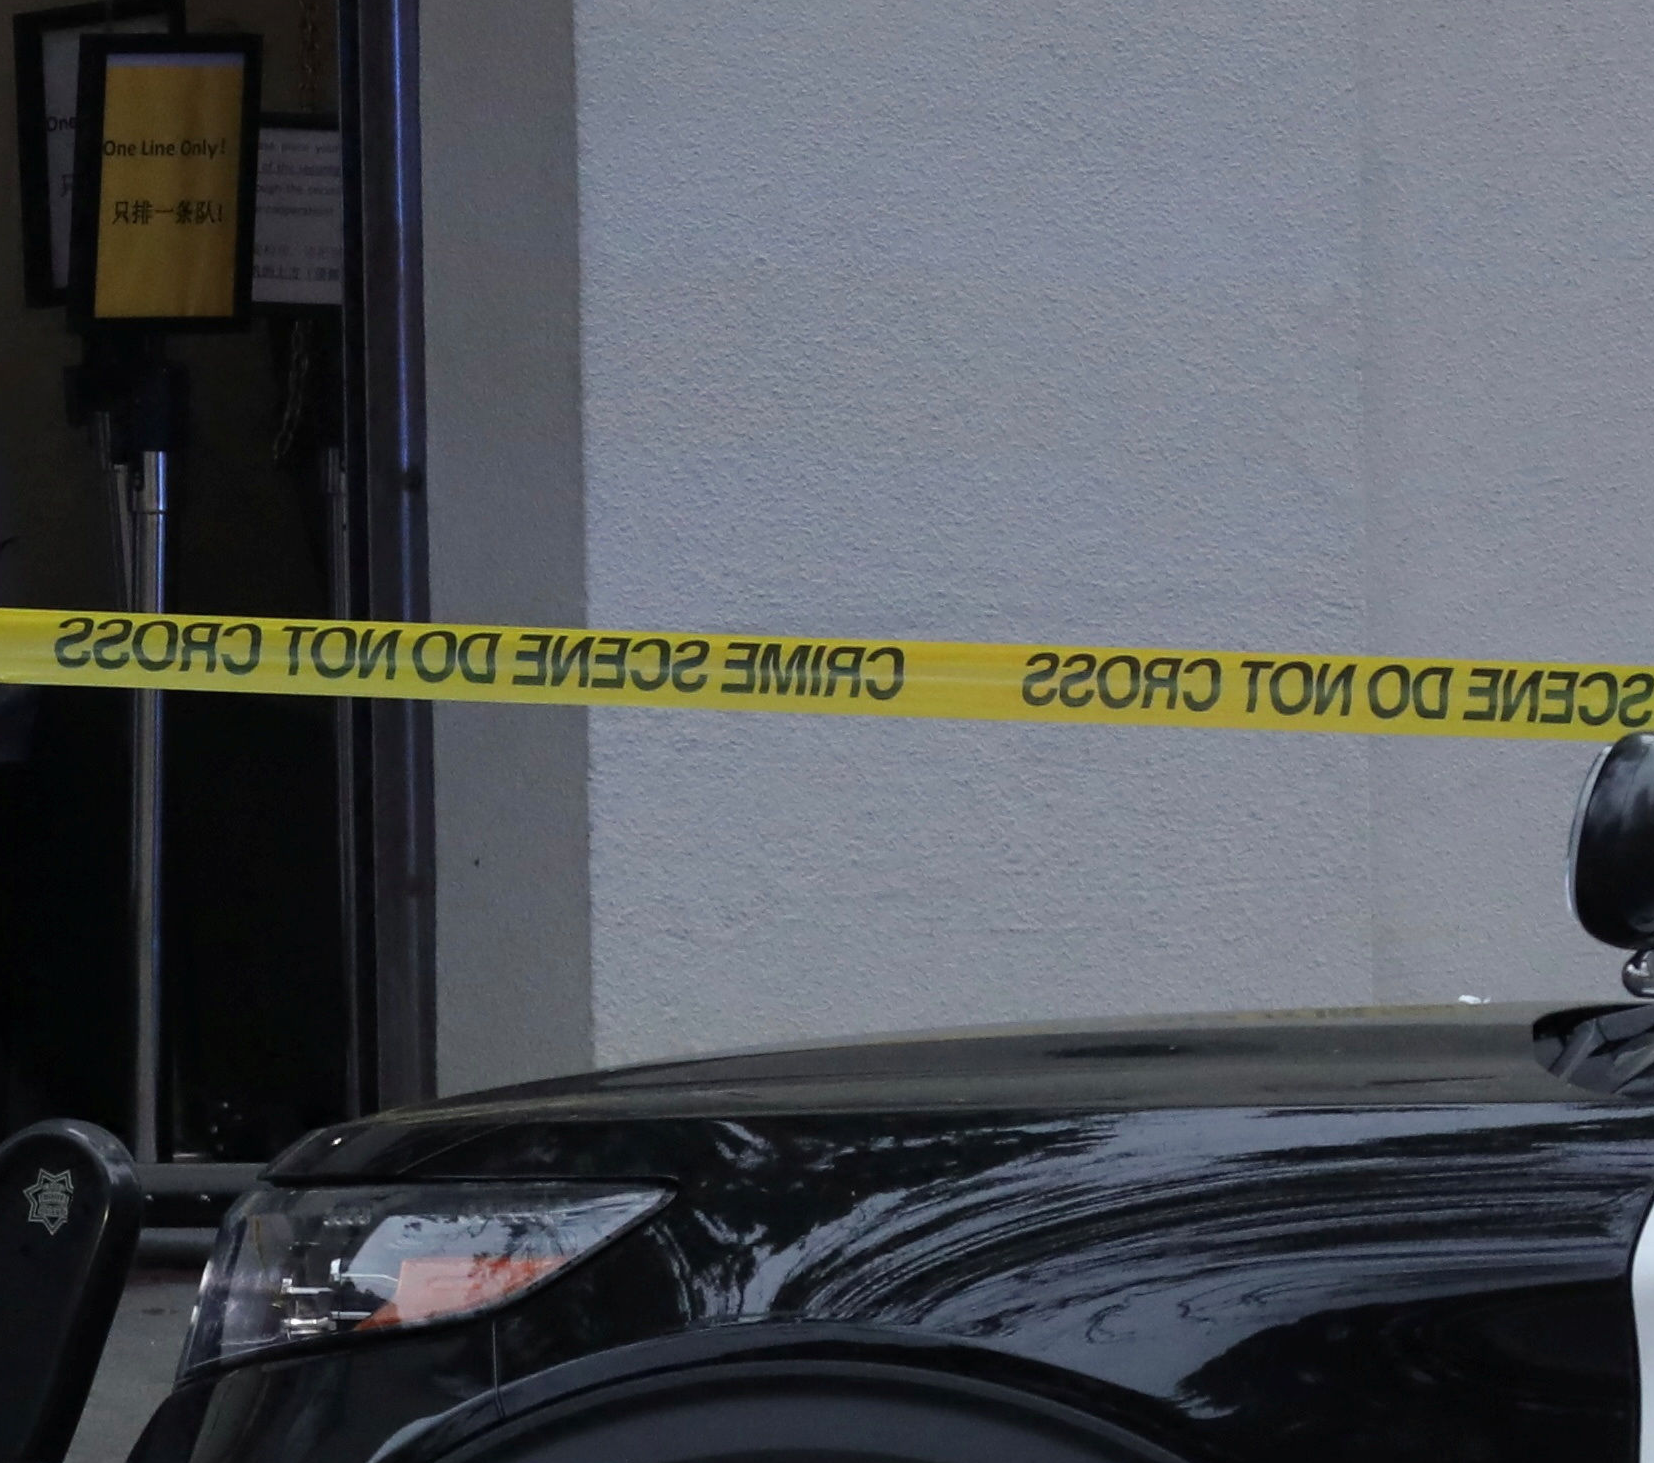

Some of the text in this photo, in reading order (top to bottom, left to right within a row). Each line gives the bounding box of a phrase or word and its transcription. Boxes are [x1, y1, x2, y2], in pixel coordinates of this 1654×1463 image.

[103, 137, 227, 161] One Line Only!
